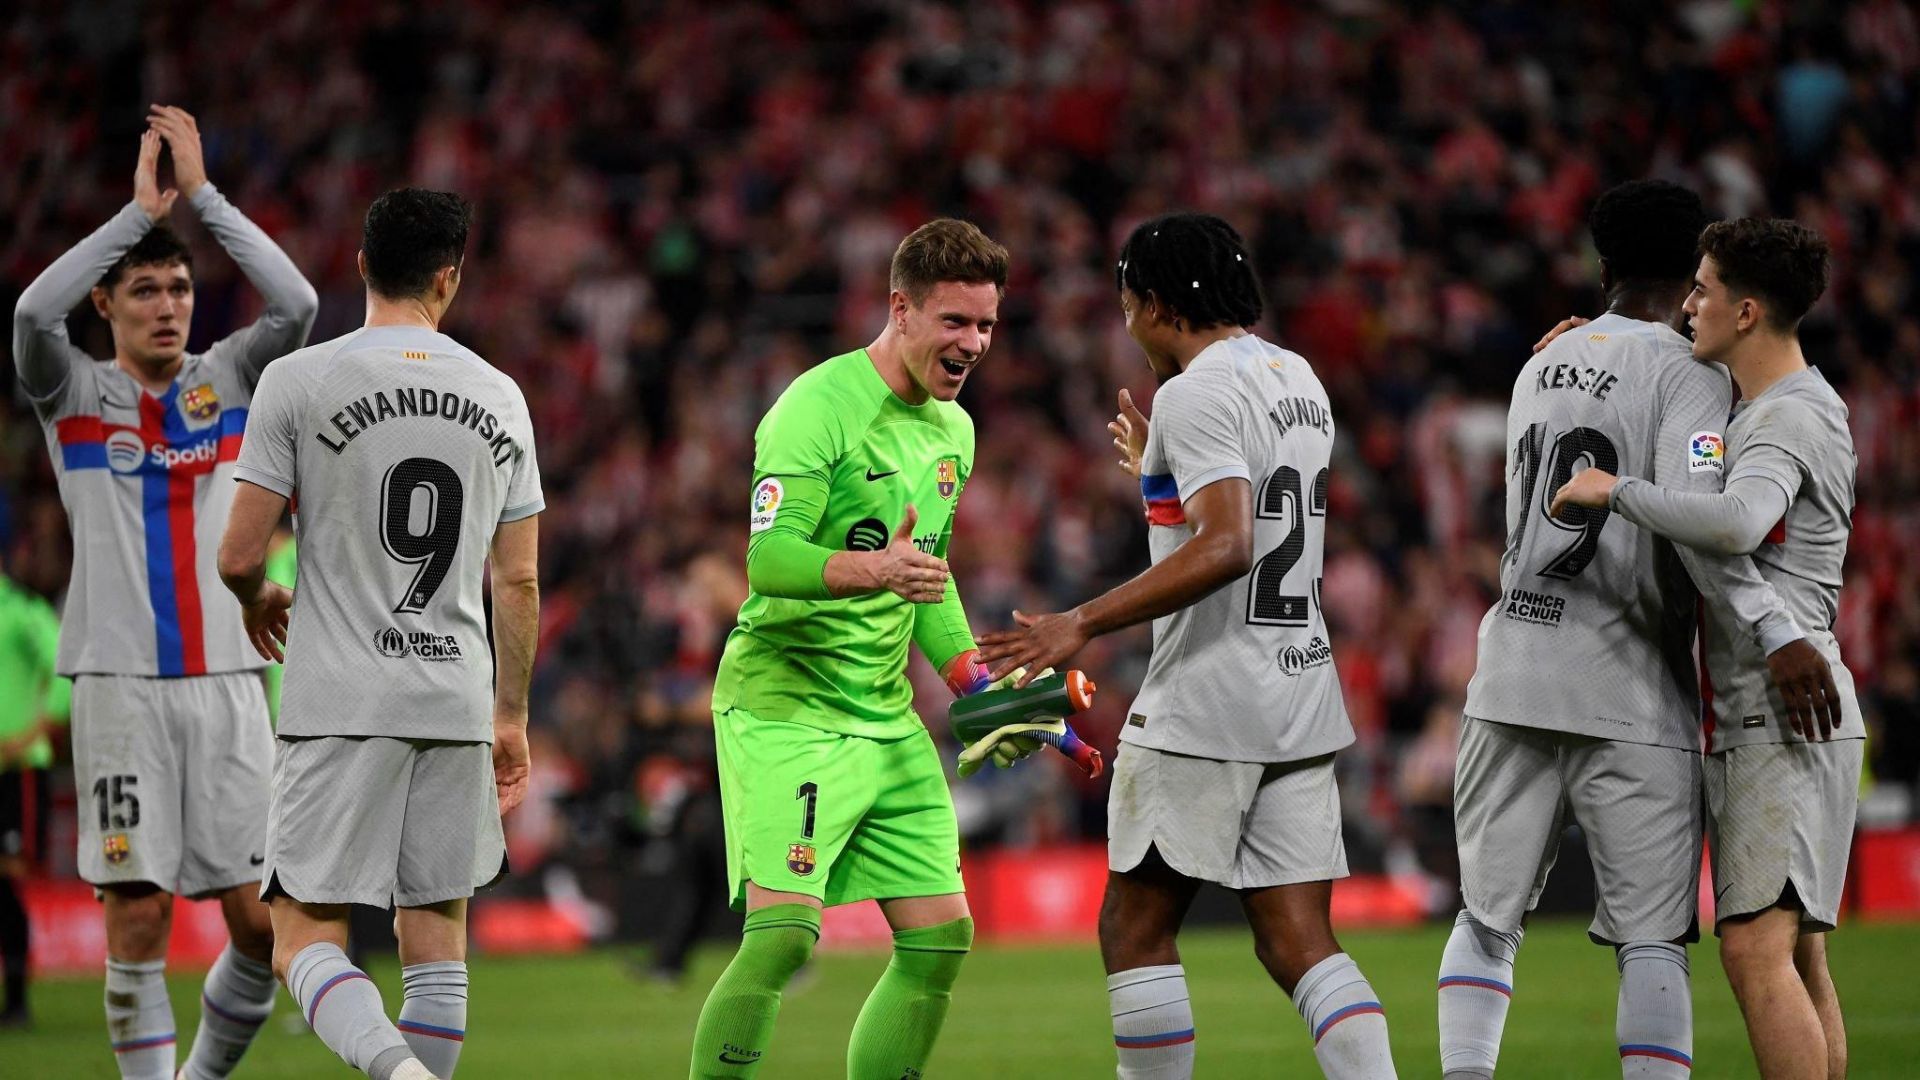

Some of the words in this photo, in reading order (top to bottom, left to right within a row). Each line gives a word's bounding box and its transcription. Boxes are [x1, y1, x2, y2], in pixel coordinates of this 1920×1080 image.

[1536, 364, 1619, 402] KESSIE
[1692, 459, 1723, 470] LaLiga
[1512, 421, 1619, 581] 19
[379, 457, 463, 615] 9
[1506, 601, 1562, 623] ACNUR
[1510, 588, 1566, 611] UNHCR
[93, 774, 140, 832] 15
[796, 781, 818, 841] 1
